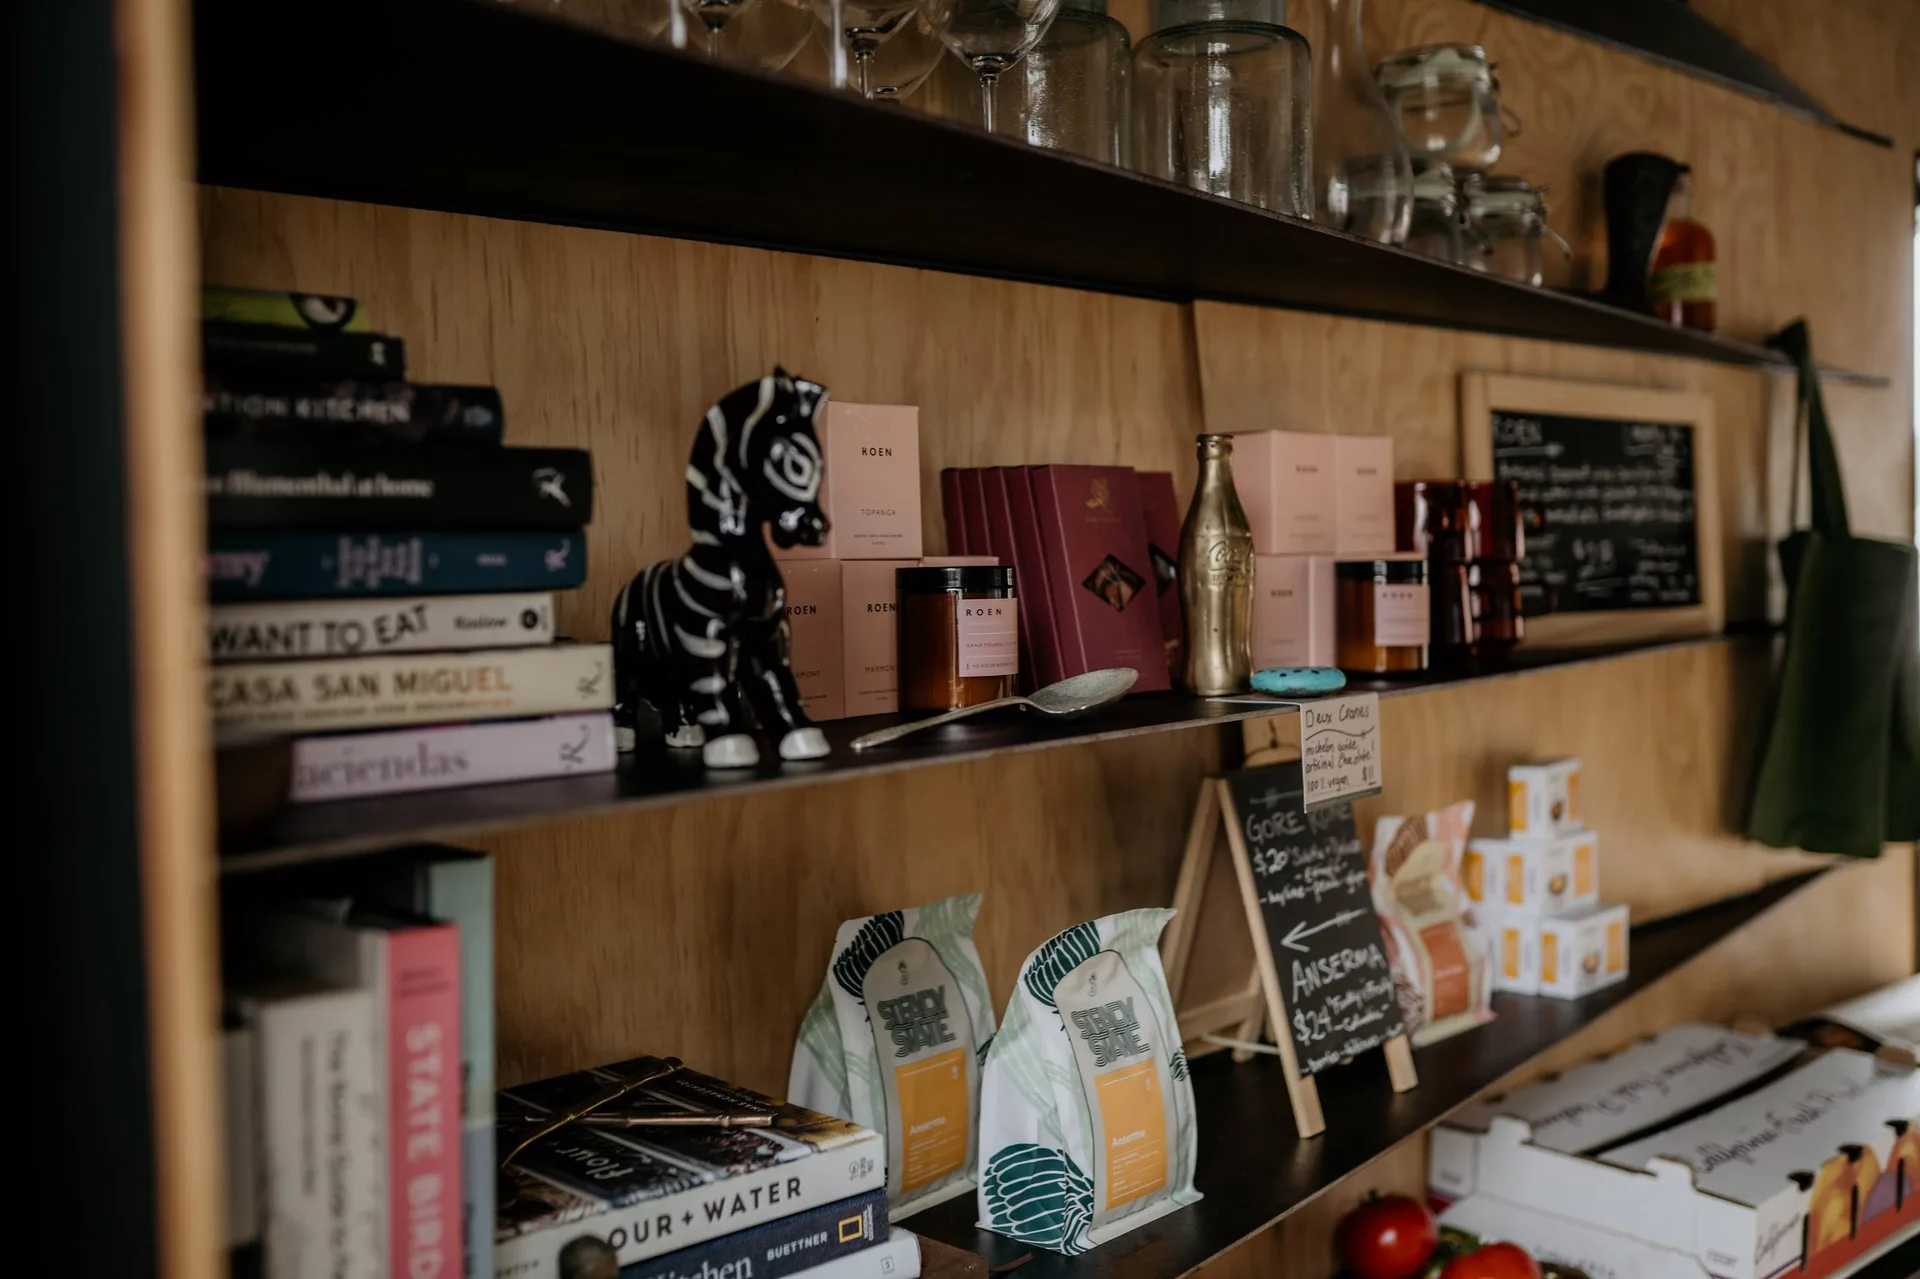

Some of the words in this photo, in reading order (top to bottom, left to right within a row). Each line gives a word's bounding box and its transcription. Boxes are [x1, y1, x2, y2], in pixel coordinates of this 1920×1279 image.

[861, 446, 893, 457] ROEN
[860, 508, 898, 516] TOPANGA
[322, 621, 368, 652] TO
[374, 602, 429, 644] EAT
[786, 605, 817, 616] ROEN
[965, 608, 1002, 617] ROEN
[312, 672, 381, 700] SAN
[393, 666, 513, 695] MIGUEL
[1305, 709, 1332, 728] Deux
[1338, 703, 1371, 722] Cranes
[1245, 809, 1306, 846] GORE
[404, 1022, 446, 1163] STATE
[702, 1176, 802, 1224] WATER
[766, 1230, 830, 1263] BUETTNER
